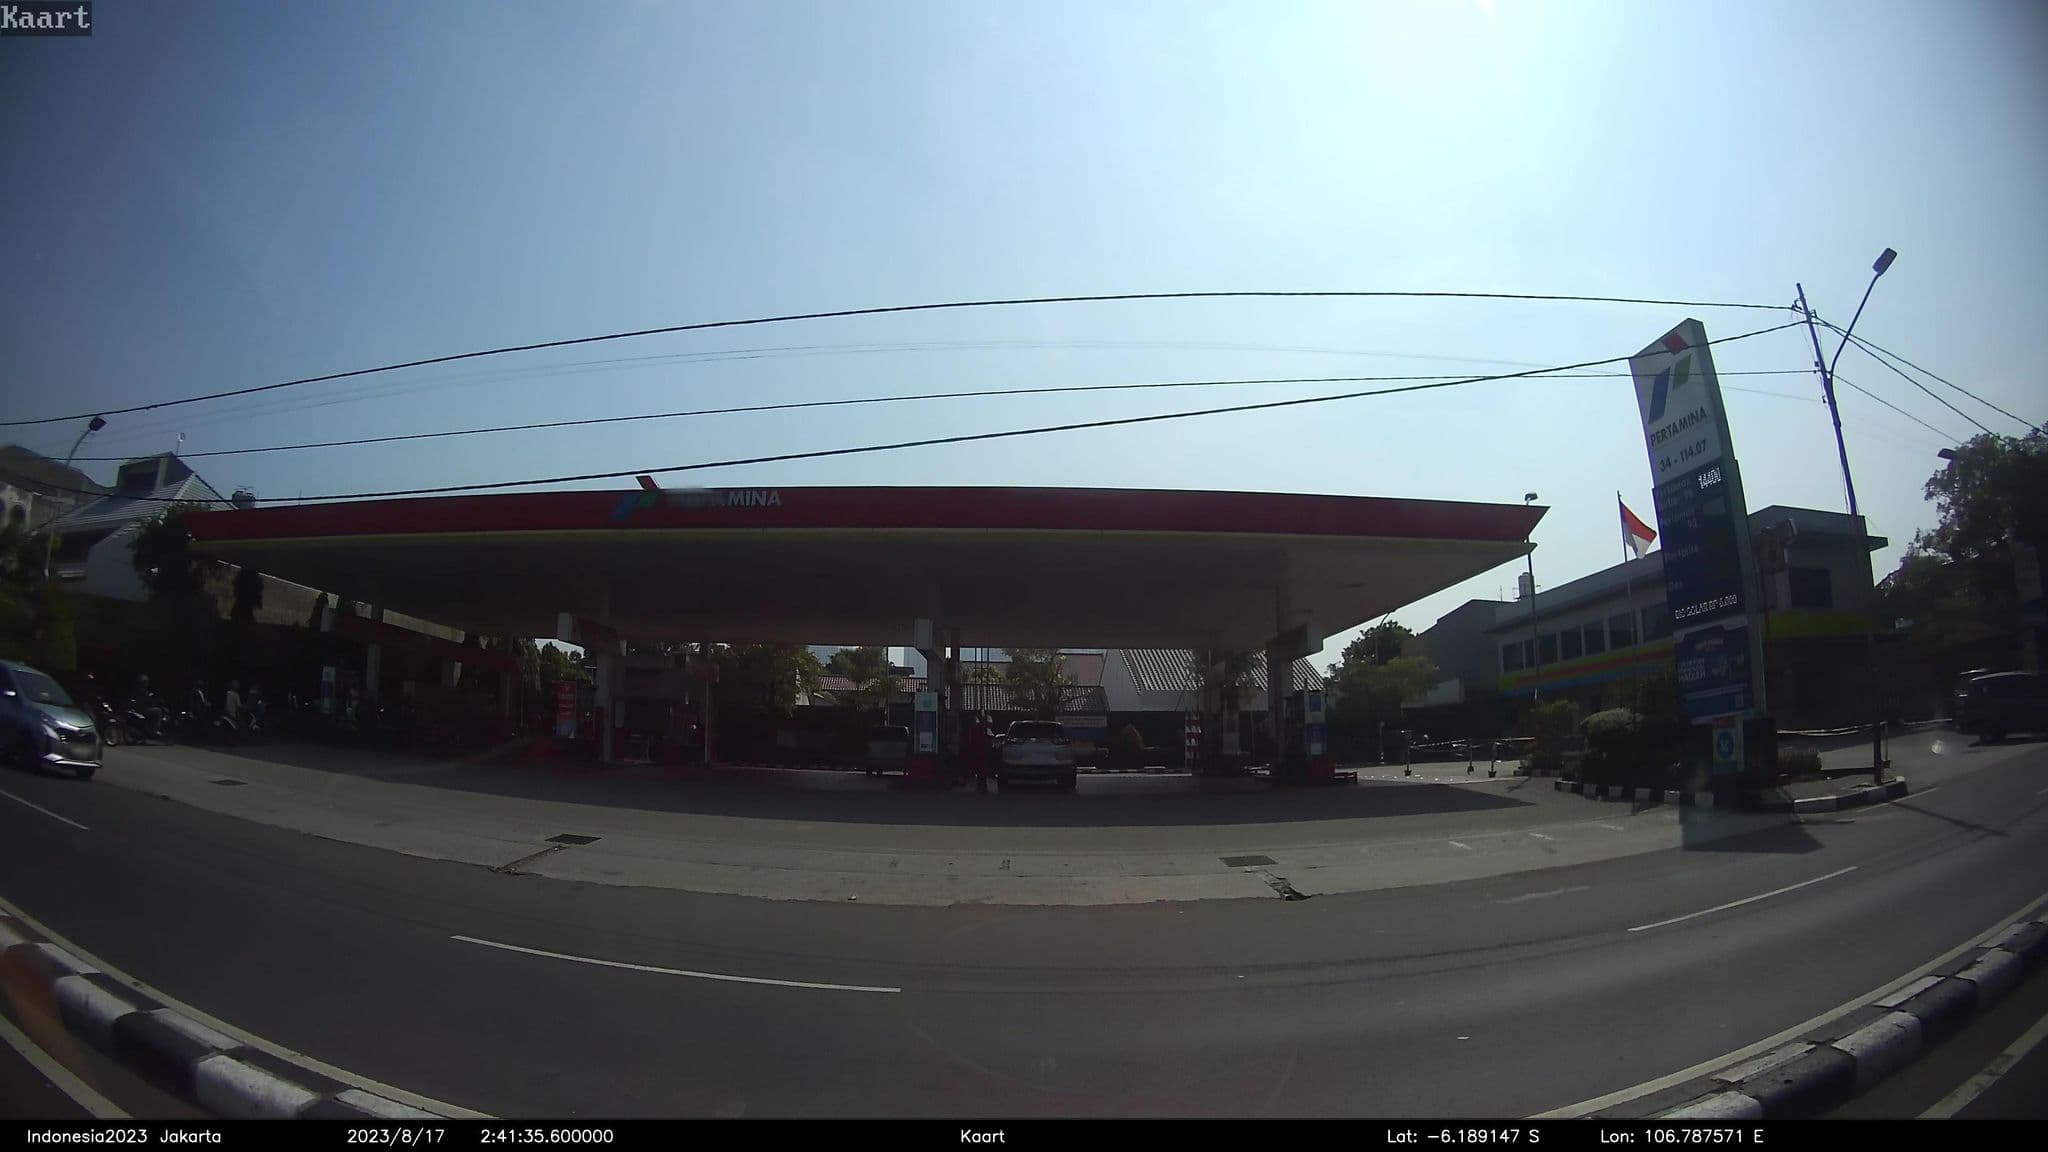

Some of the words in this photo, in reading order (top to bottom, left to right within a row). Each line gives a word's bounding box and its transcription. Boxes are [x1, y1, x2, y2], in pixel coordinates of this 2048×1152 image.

[1650, 407, 1708, 447] PERTAMINA
[1660, 456, 1671, 472] 34
[1680, 438, 1706, 462] 114.07
